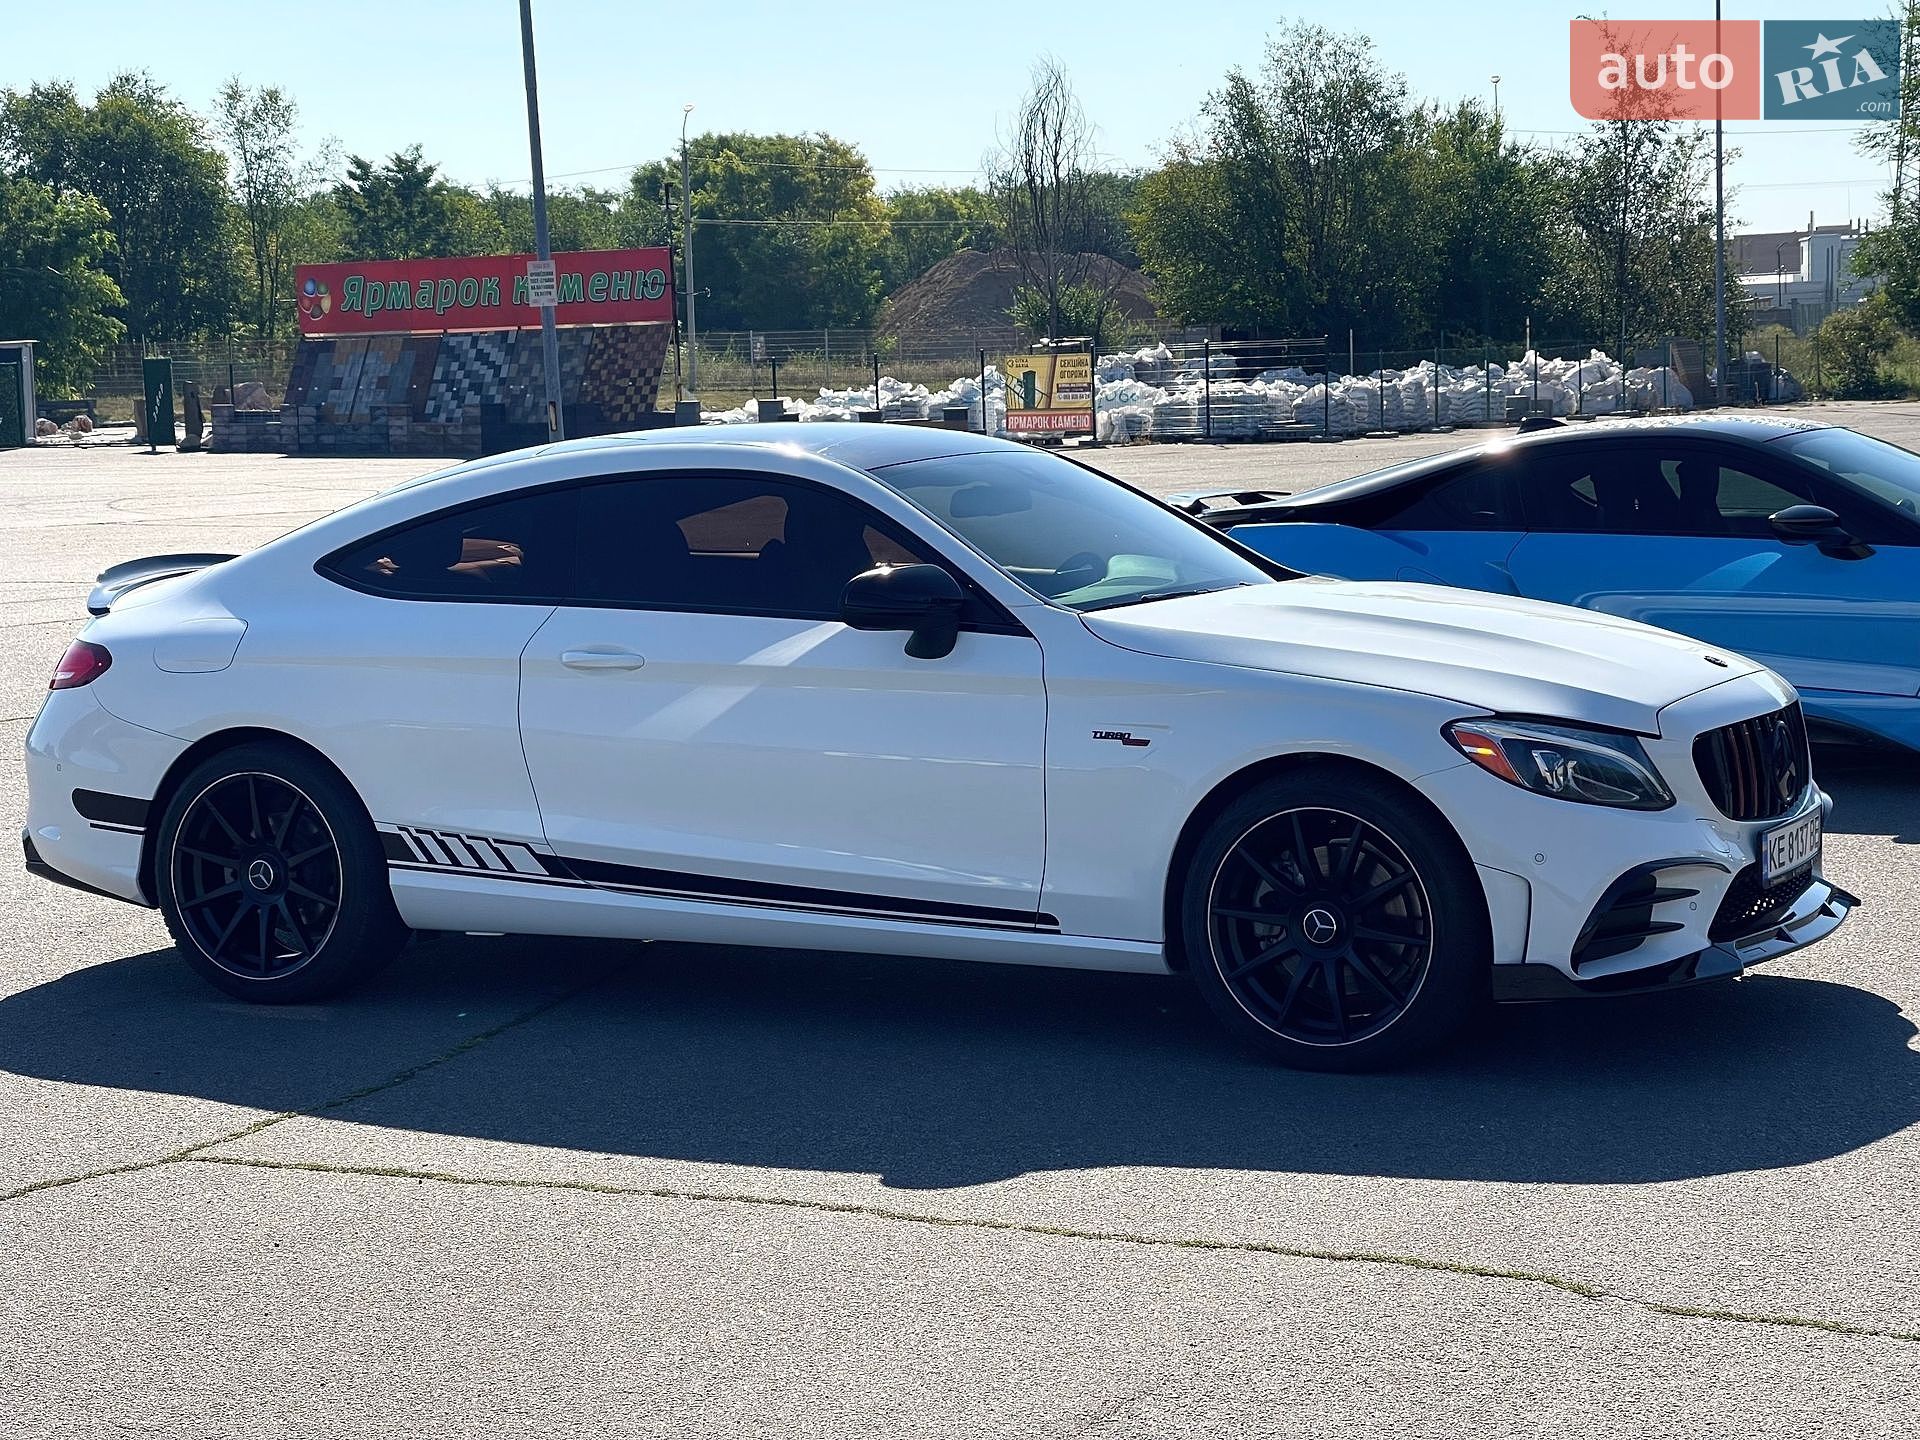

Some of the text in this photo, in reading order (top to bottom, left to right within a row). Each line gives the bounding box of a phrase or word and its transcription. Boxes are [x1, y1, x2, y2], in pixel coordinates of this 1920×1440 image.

[340, 267, 667, 318] Ярмарок кменю
[1059, 370, 1088, 379] ОГОРОЖА
[1008, 414, 1090, 429] ЯРМАРОК КАМЕНЮ
[1091, 730, 1132, 740] TURBO
[1769, 815, 1820, 873] KE 8137 BE
